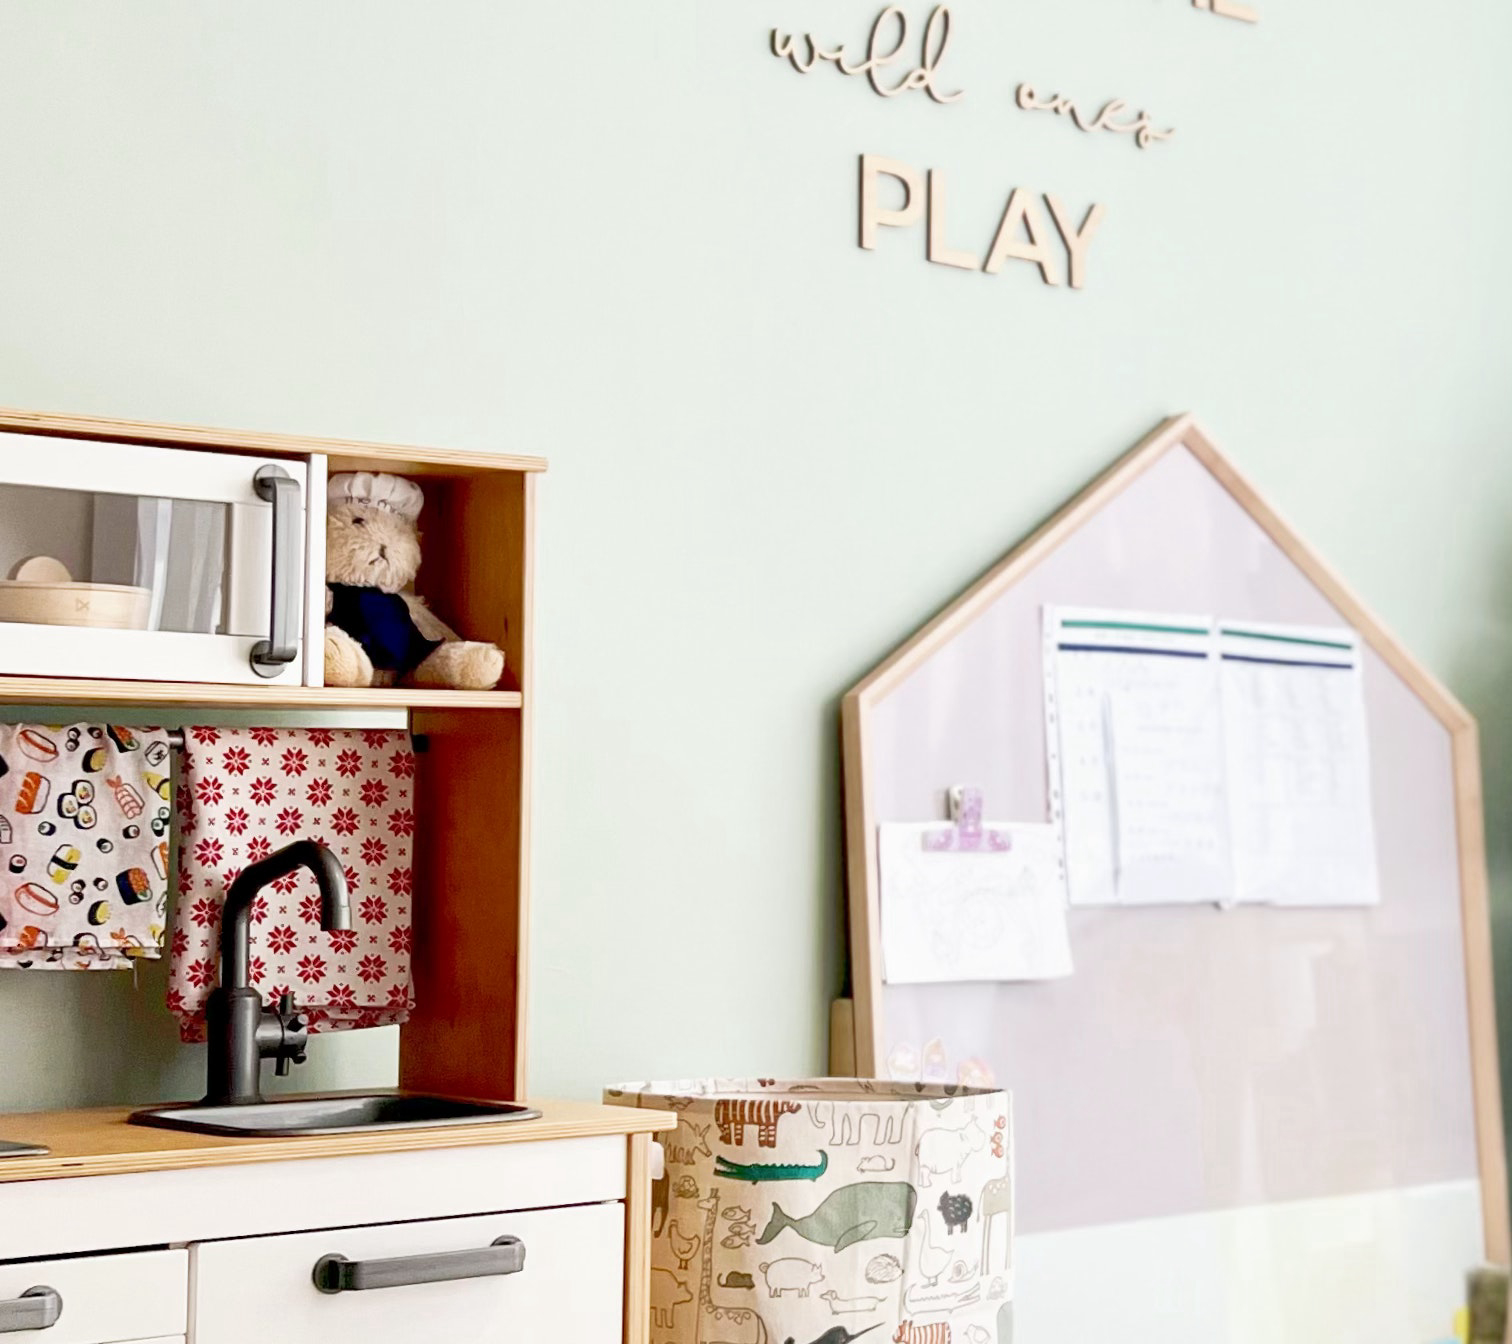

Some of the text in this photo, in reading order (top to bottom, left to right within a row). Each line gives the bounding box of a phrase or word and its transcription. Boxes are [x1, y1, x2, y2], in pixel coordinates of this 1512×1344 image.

[767, 4, 1176, 152] wild ones
[857, 152, 1107, 291] PLAY
